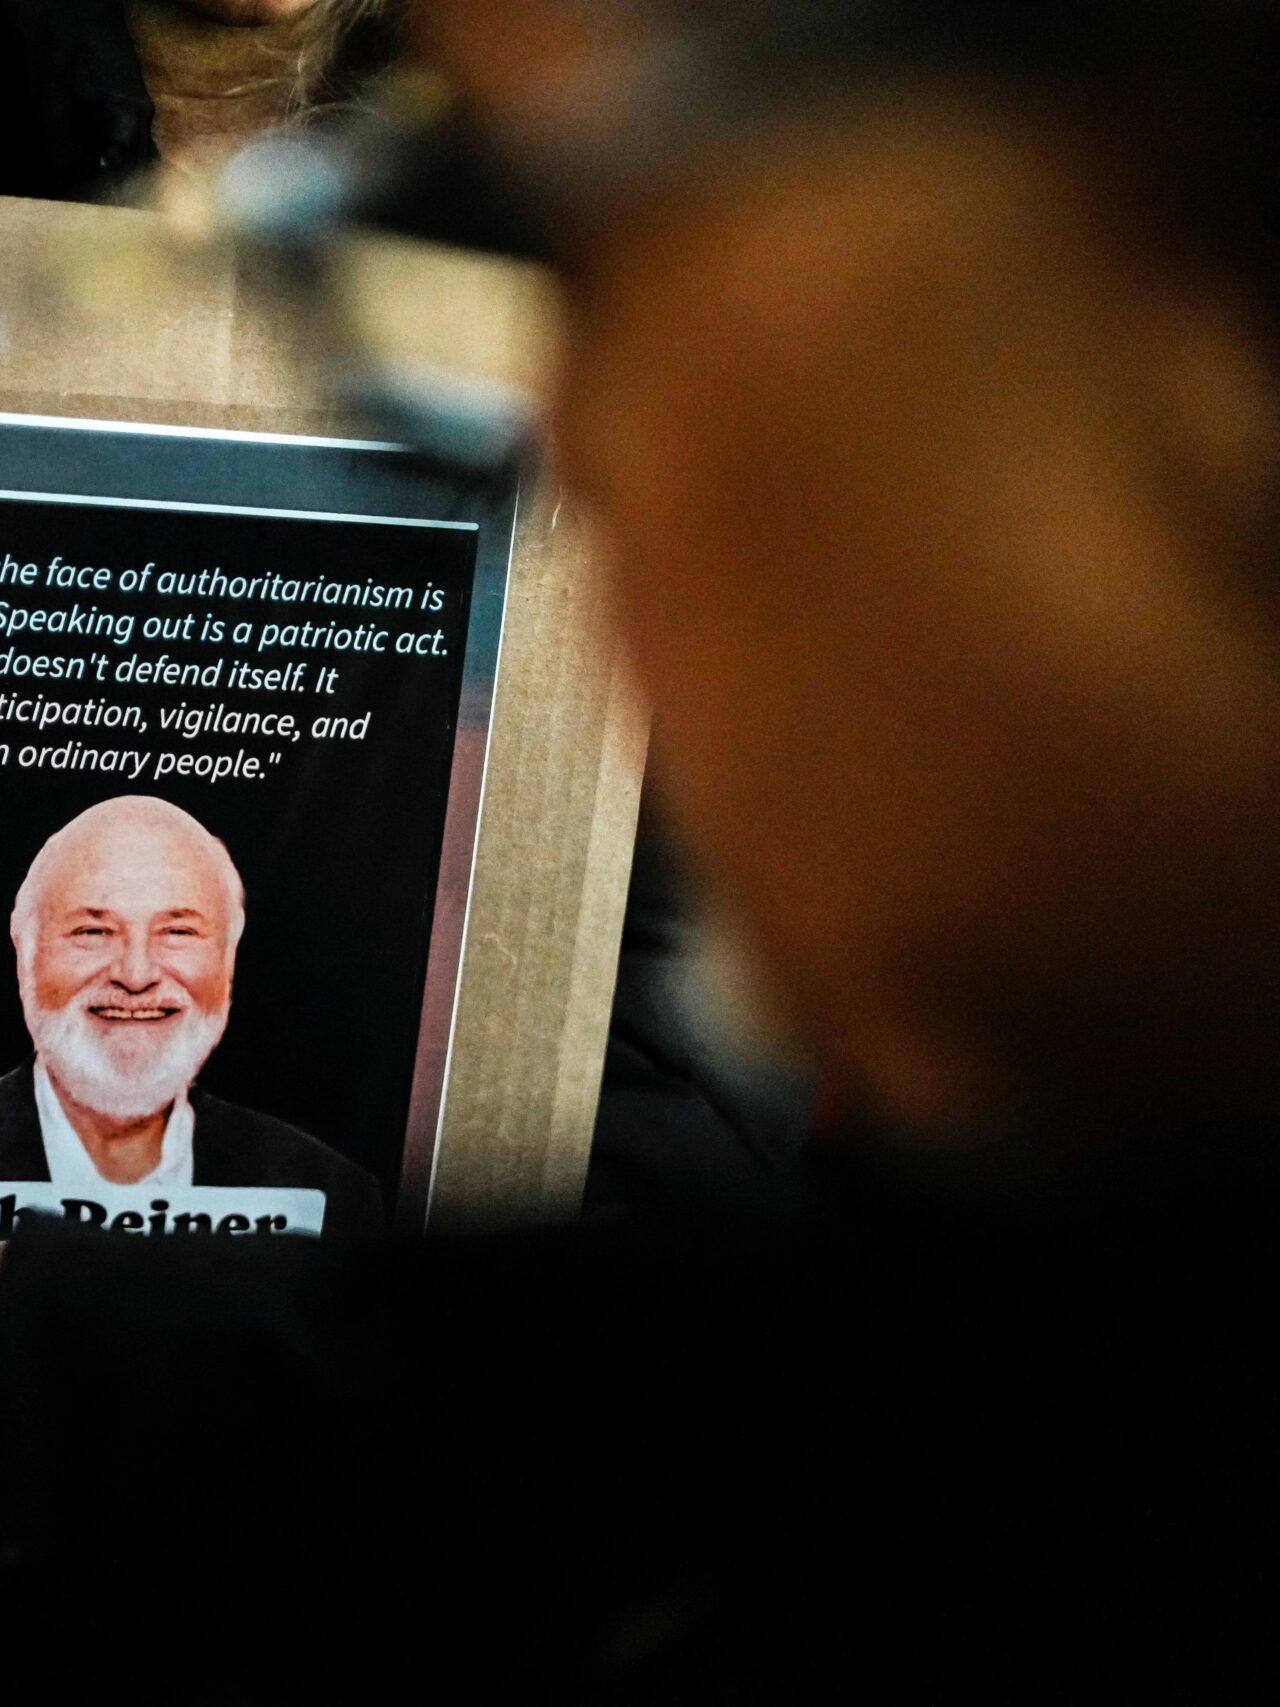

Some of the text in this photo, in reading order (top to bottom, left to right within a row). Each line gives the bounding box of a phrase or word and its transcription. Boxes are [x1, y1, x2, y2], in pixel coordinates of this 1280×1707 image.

[45, 556, 112, 590] face
[118, 561, 156, 592] of
[156, 567, 414, 609] authoritarianism
[420, 581, 445, 612] is
[142, 613, 196, 640] out
[200, 612, 226, 643] is
[232, 622, 253, 644] a
[257, 620, 389, 653] patriotic
[395, 628, 448, 656] act.
[114, 653, 224, 687] defend
[227, 660, 308, 693] itself.
[315, 666, 340, 695] It
[160, 701, 301, 743] vigilance,
[311, 711, 372, 740] and
[18, 740, 152, 780] ordinary
[153, 748, 282, 784] people."
